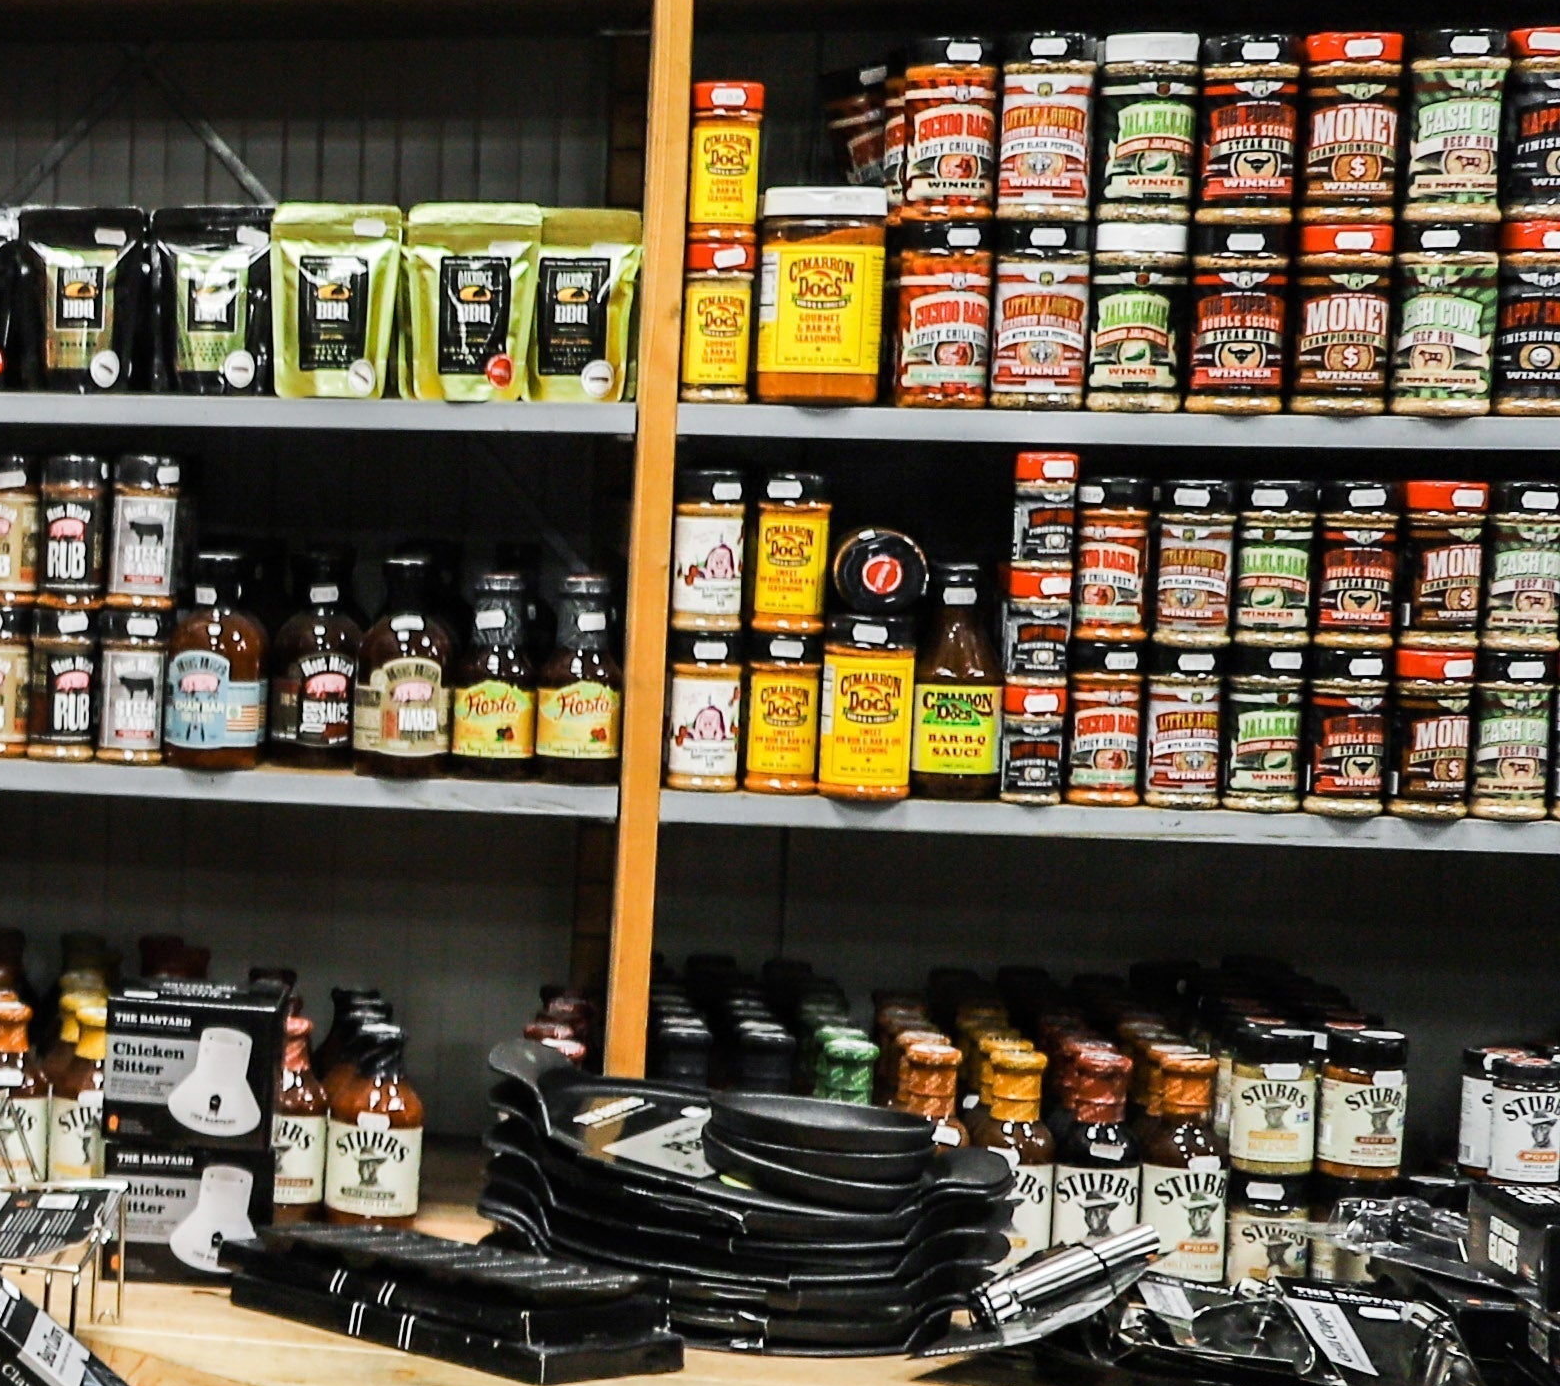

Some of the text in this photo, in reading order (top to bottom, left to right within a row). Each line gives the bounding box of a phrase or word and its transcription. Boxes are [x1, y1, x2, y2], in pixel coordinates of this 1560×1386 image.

[1005, 107, 1041, 128] LITTLE
[1422, 111, 1470, 134] CASH
[1313, 109, 1398, 145] MONEY
[703, 132, 752, 156] CIMARRON
[1228, 139, 1262, 152] STEAK
[1443, 136, 1495, 150] BEEF RUB
[920, 143, 945, 159] SPICY
[1309, 144, 1382, 162] CHAMPIONSHIP
[927, 180, 985, 191] WINNER
[1009, 176, 1072, 188] WINNER
[1128, 177, 1183, 187] WINNER
[1222, 176, 1286, 189] WINNER
[1322, 181, 1388, 192] WINNER
[789, 255, 854, 285] CIMARRON
[698, 296, 745, 317] CIMARRON
[799, 313, 840, 324] GOURMET
[1306, 300, 1389, 336] MONEY
[1443, 302, 1476, 327] COW
[807, 324, 841, 334] BAR-B-Q
[1202, 316, 1280, 331] DOUBLE SECRET
[794, 334, 841, 345] SEASONING
[1213, 329, 1250, 342] STEAK
[1302, 334, 1376, 353] CHAMPIONSHIP
[1011, 365, 1070, 377] WINNER
[1207, 367, 1272, 380] WINNER
[1315, 371, 1379, 382] WINNER
[765, 524, 813, 547] CIMARRON
[1499, 550, 1540, 578] CASH
[841, 670, 903, 699] CIMARRON
[761, 685, 810, 708] CIMARRON
[1482, 719, 1524, 744] CASH
[928, 733, 986, 747] BAR-B-Q
[932, 746, 983, 760] SAUCE
